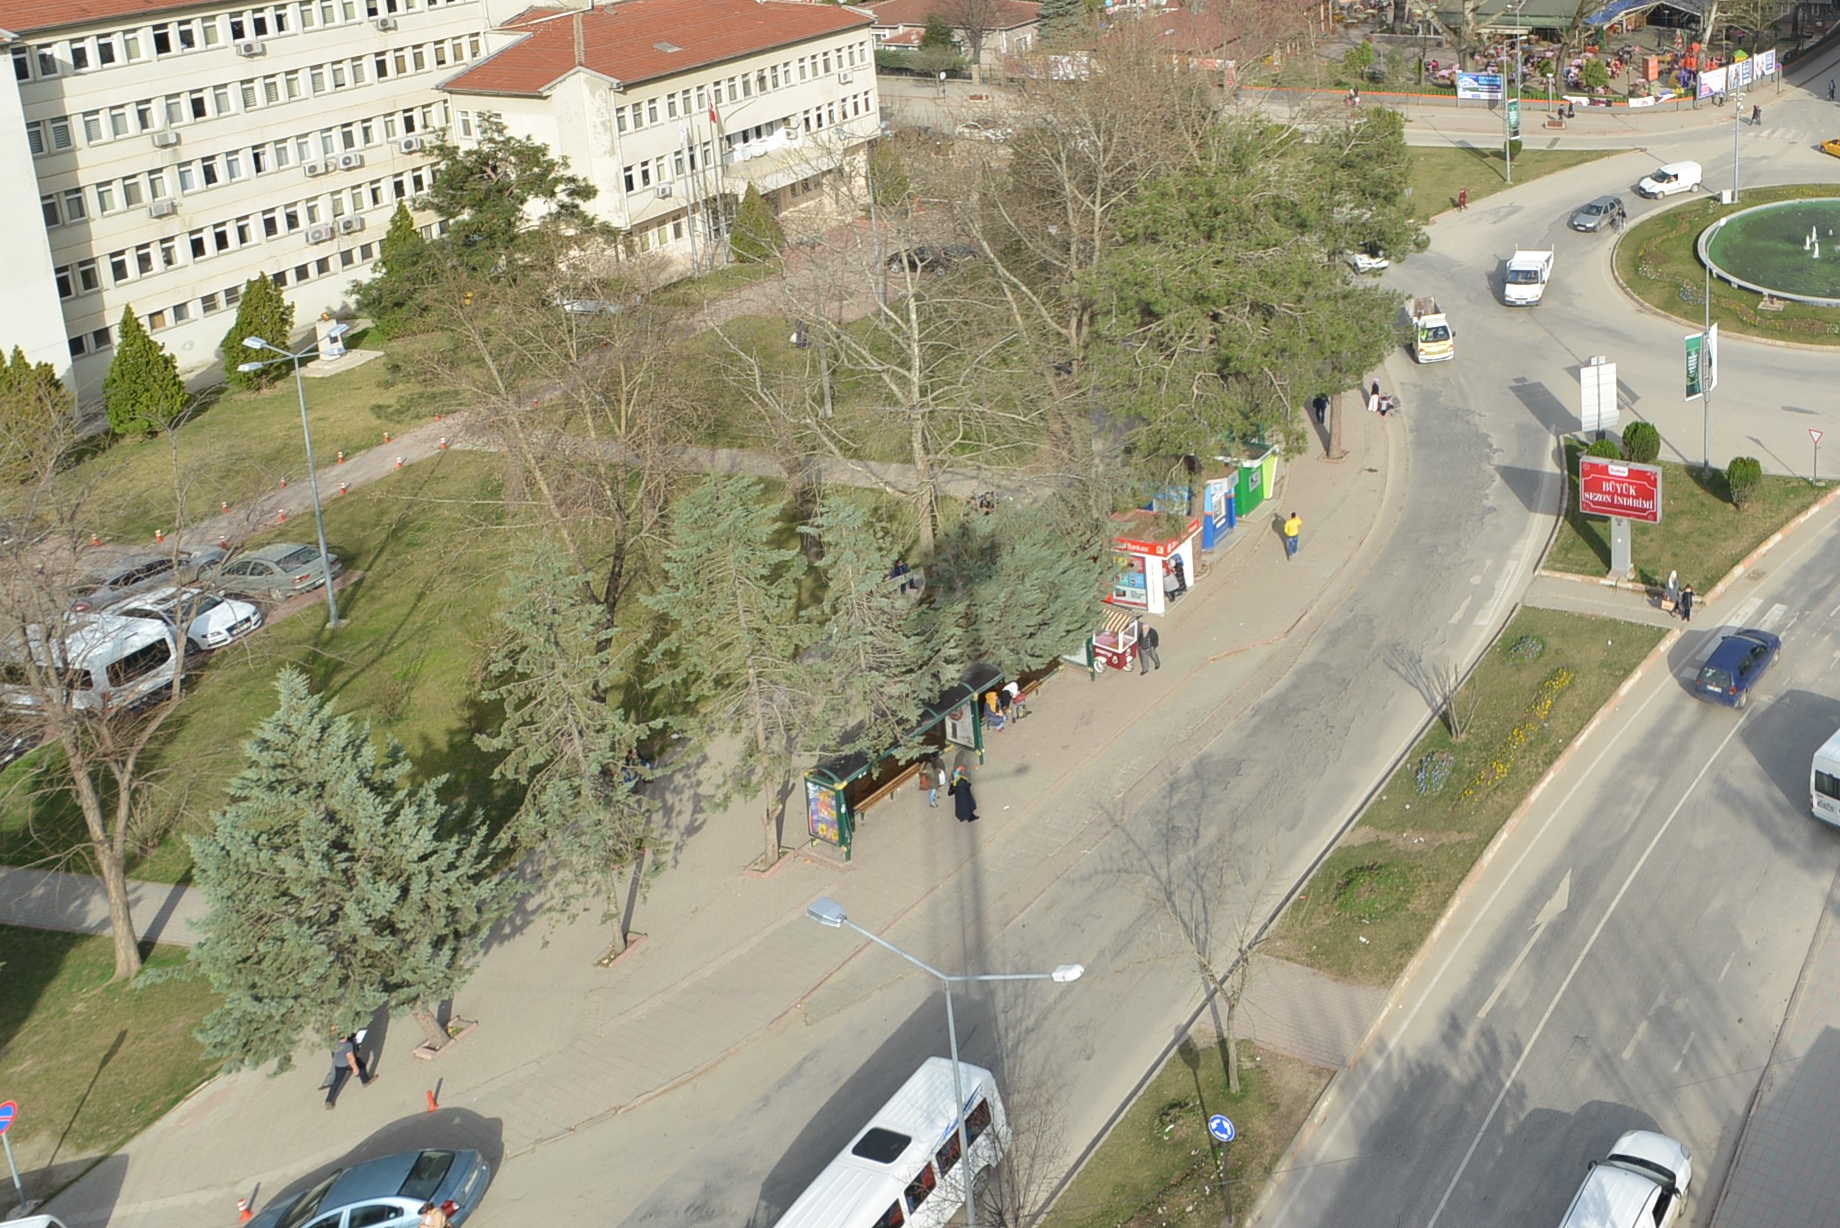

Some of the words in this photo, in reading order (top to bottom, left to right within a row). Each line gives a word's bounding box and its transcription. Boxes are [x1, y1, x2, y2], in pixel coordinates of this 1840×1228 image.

[1602, 480, 1637, 496] BÜYÜK
[1584, 491, 1612, 503] SEZON
[1613, 493, 1653, 510] İNDİRİMİ
